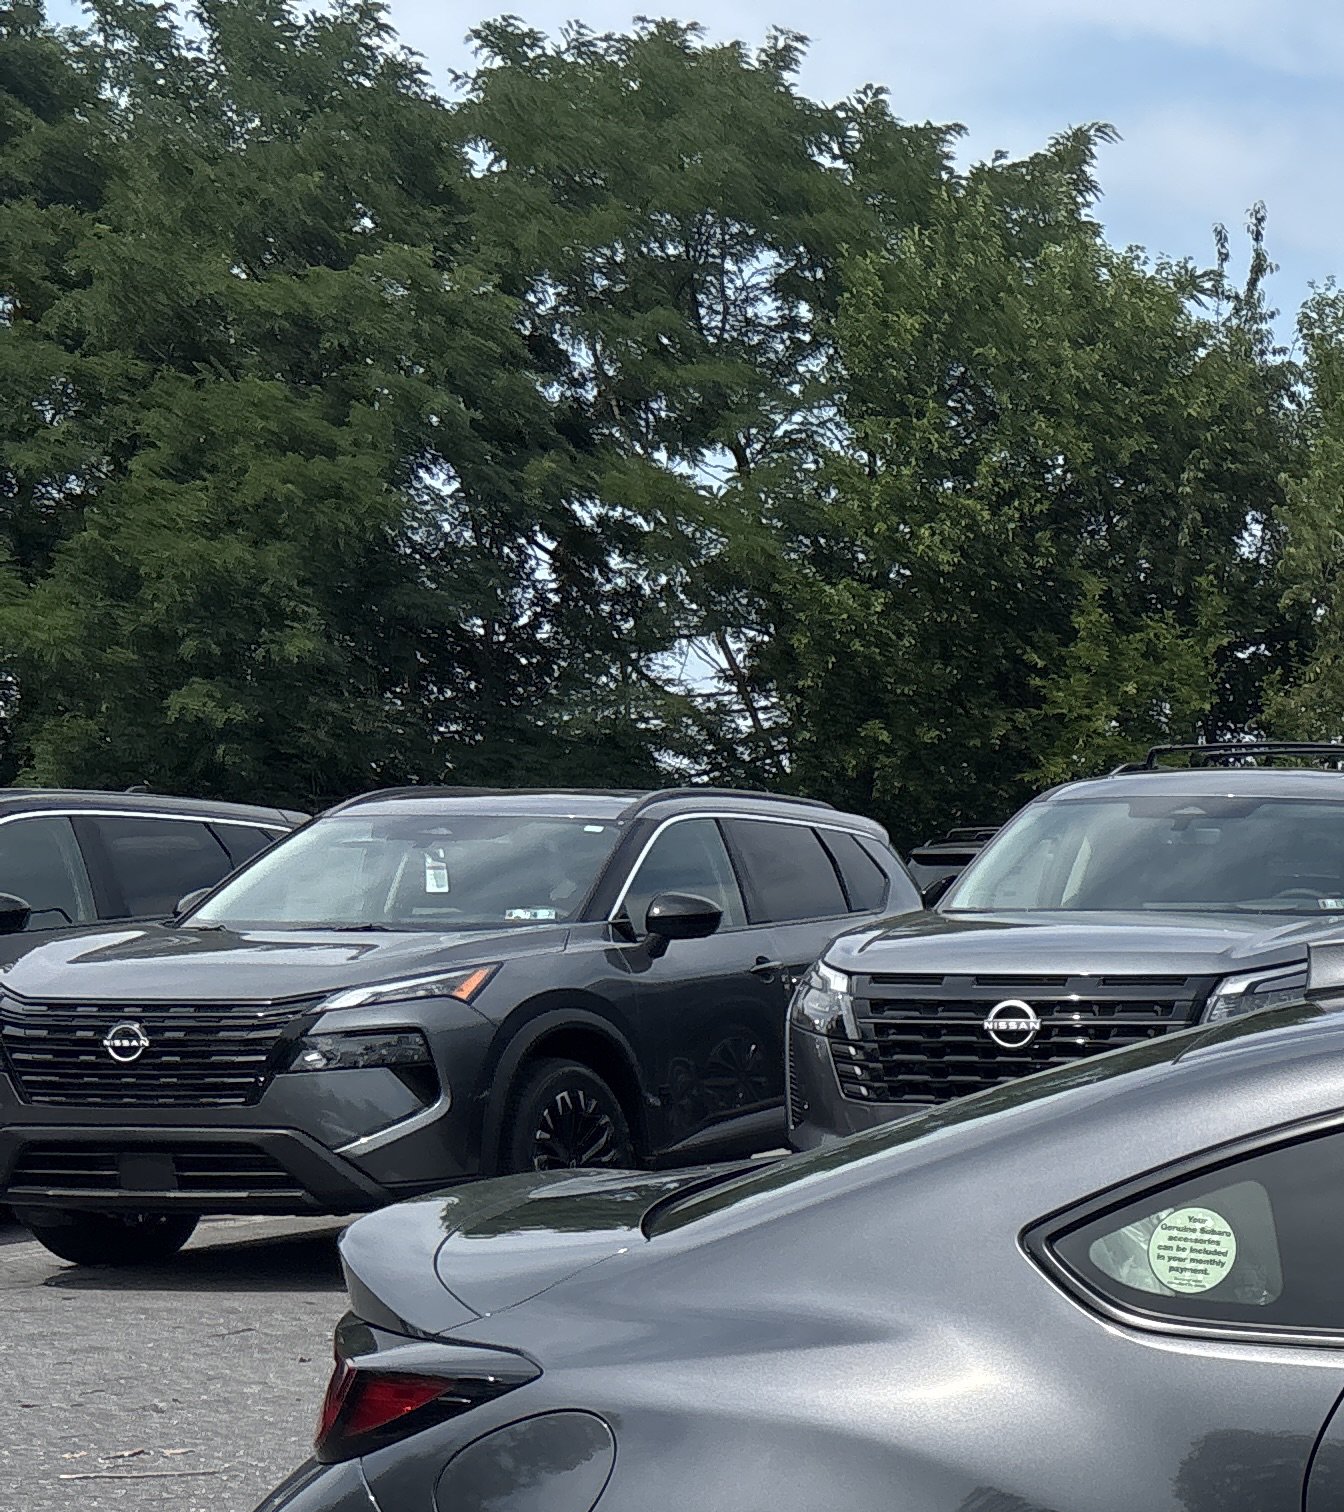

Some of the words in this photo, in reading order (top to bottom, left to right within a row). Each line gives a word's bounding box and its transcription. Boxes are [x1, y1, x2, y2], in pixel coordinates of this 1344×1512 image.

[984, 1020, 1041, 1030] NISSAN
[103, 1039, 150, 1047] NISSAN
[1188, 1216, 1207, 1224] Your
[1161, 1223, 1197, 1233] Genuine
[1168, 1235, 1221, 1246] accessories
[1175, 1244, 1187, 1252] be
[1190, 1246, 1228, 1257] included
[1167, 1255, 1188, 1263] your
[1190, 1258, 1226, 1268] monthly
